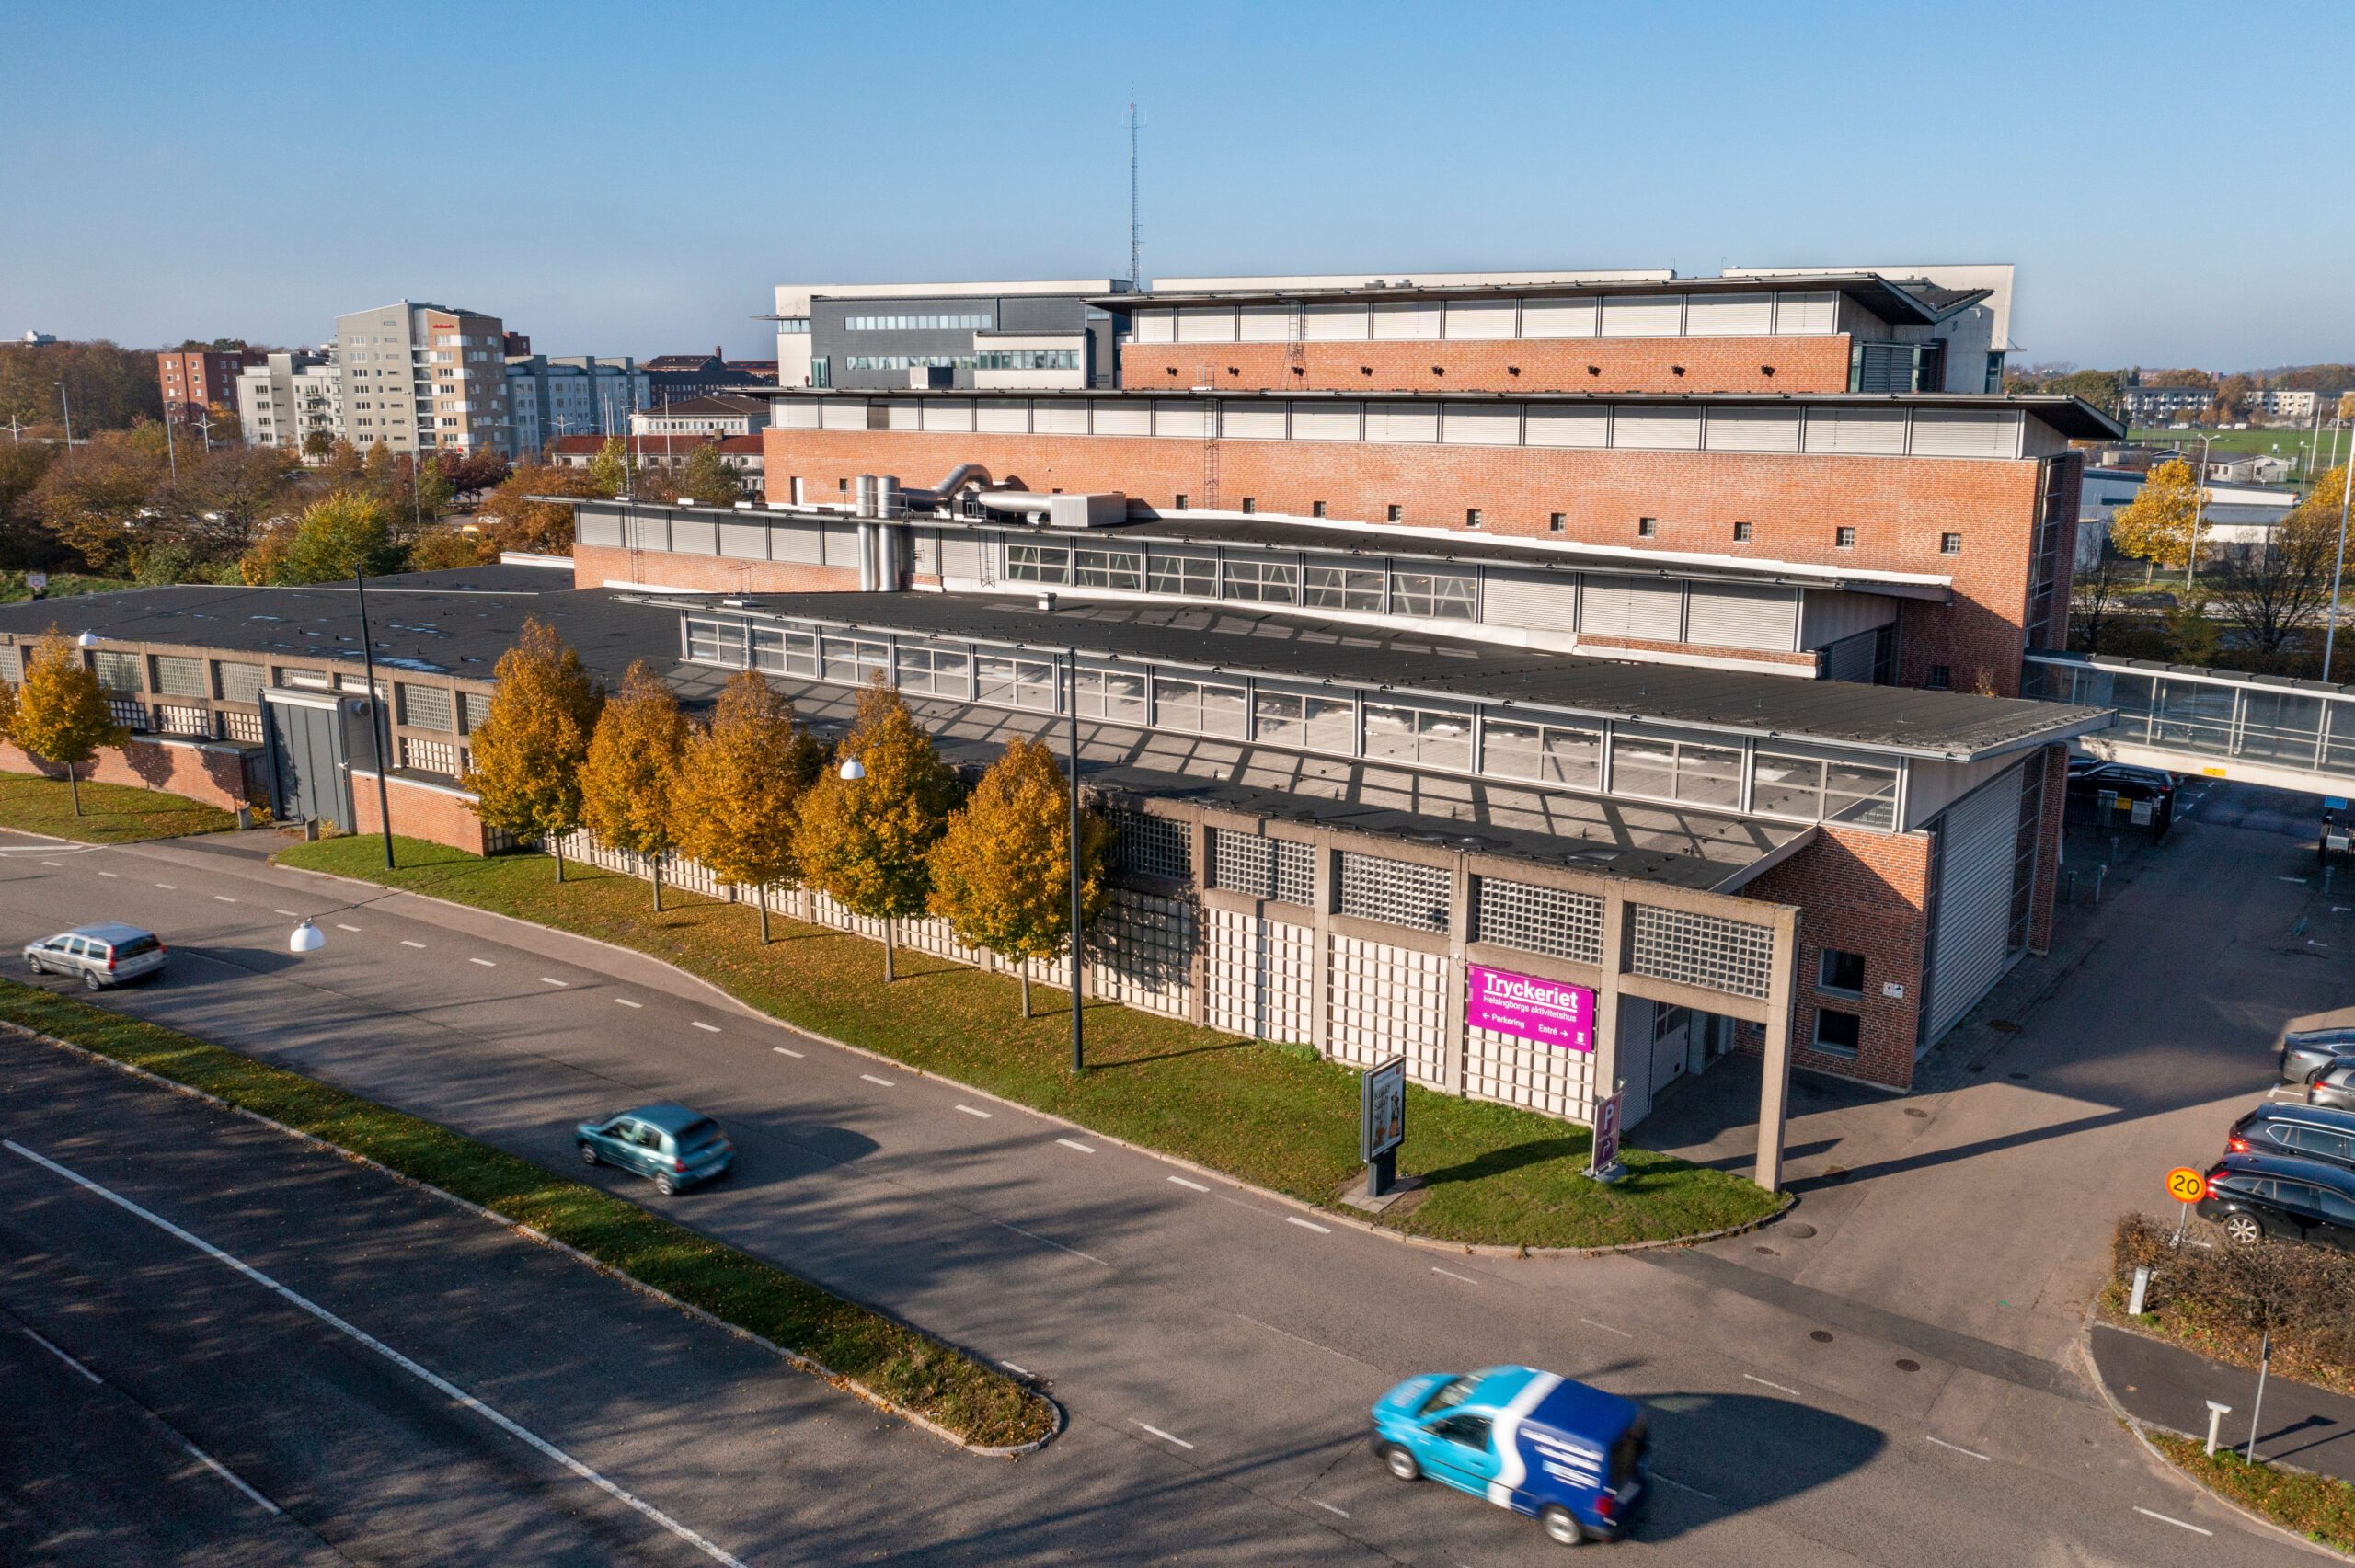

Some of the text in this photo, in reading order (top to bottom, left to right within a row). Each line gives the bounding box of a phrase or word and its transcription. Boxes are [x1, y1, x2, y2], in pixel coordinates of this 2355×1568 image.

[1484, 972, 1578, 1009] Tryckeriet
[1483, 995, 1577, 1023] Helsingborgs aktivitetshus
[1491, 1013, 1557, 1036] Parkering Entré
[1604, 1104, 1614, 1130] P
[2173, 1175, 2200, 1195] 20
